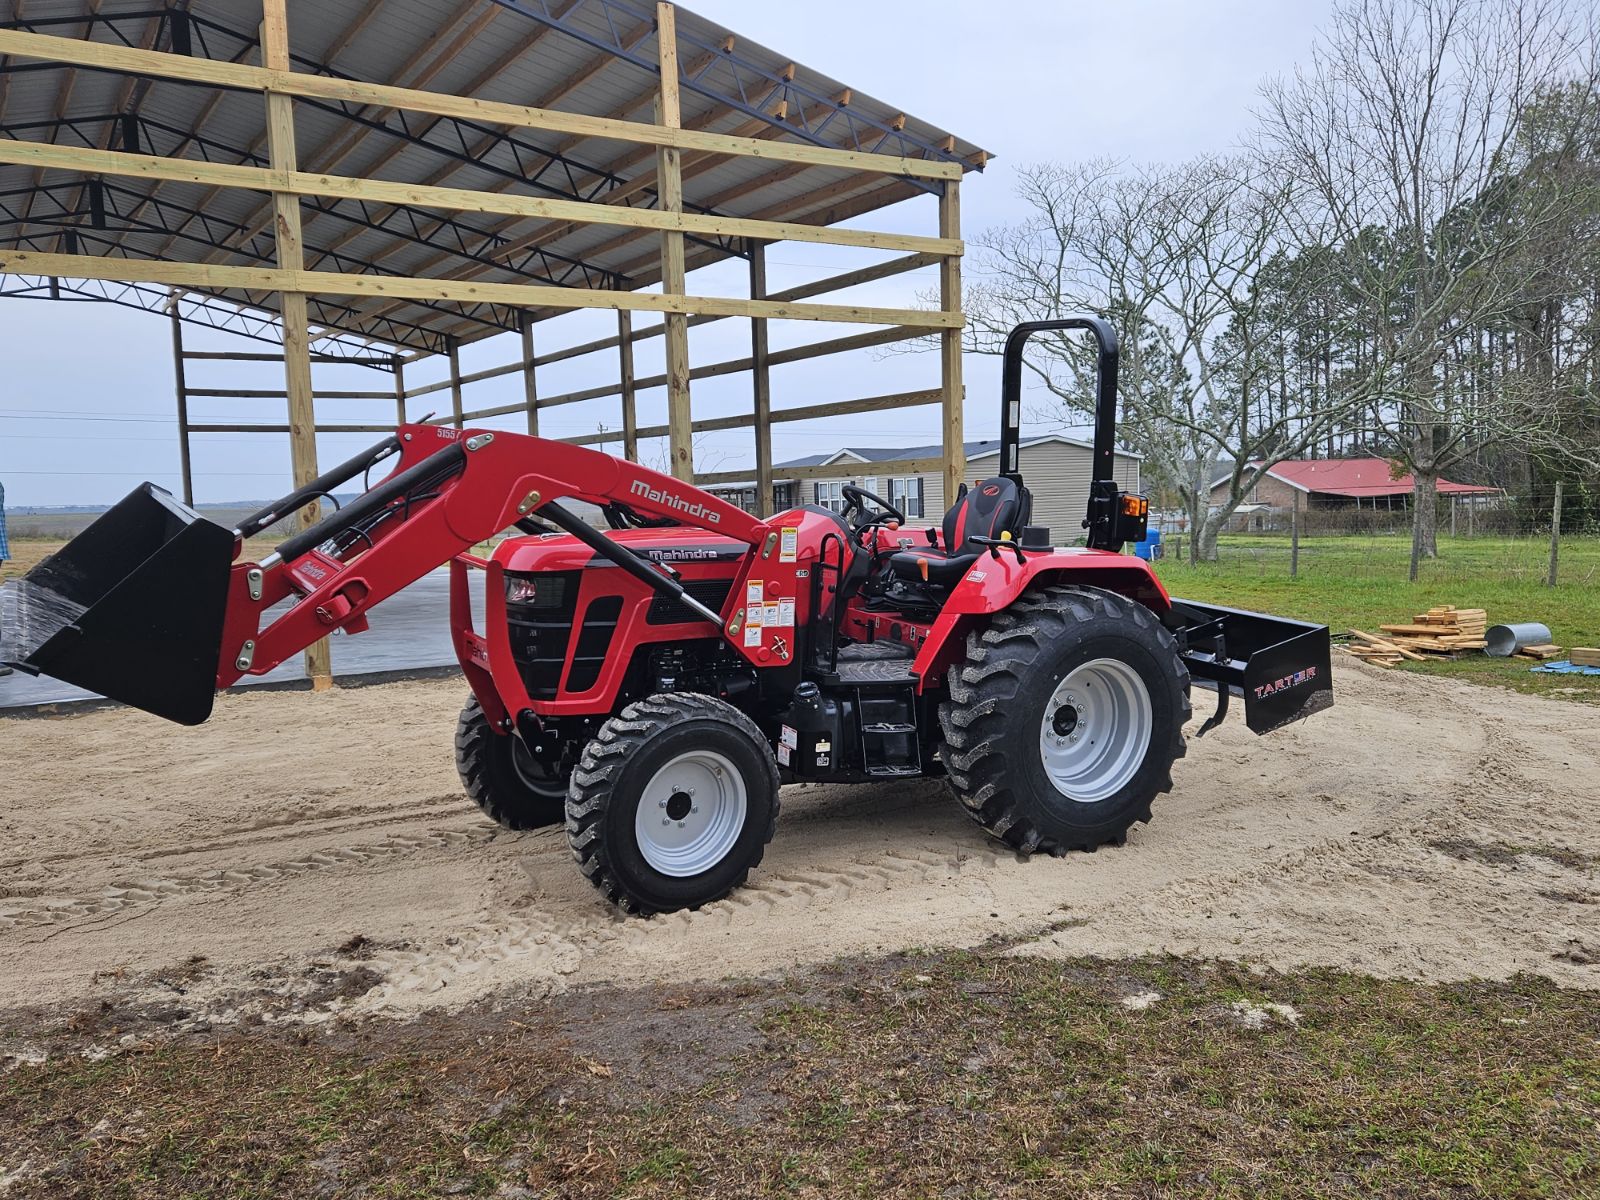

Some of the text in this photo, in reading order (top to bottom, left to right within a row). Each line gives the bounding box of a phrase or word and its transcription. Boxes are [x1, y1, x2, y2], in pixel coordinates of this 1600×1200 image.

[437, 428, 456, 440] 5155
[630, 479, 721, 524] Mahindra
[648, 549, 718, 562] Mahindra
[1254, 666, 1317, 697] TARTER
